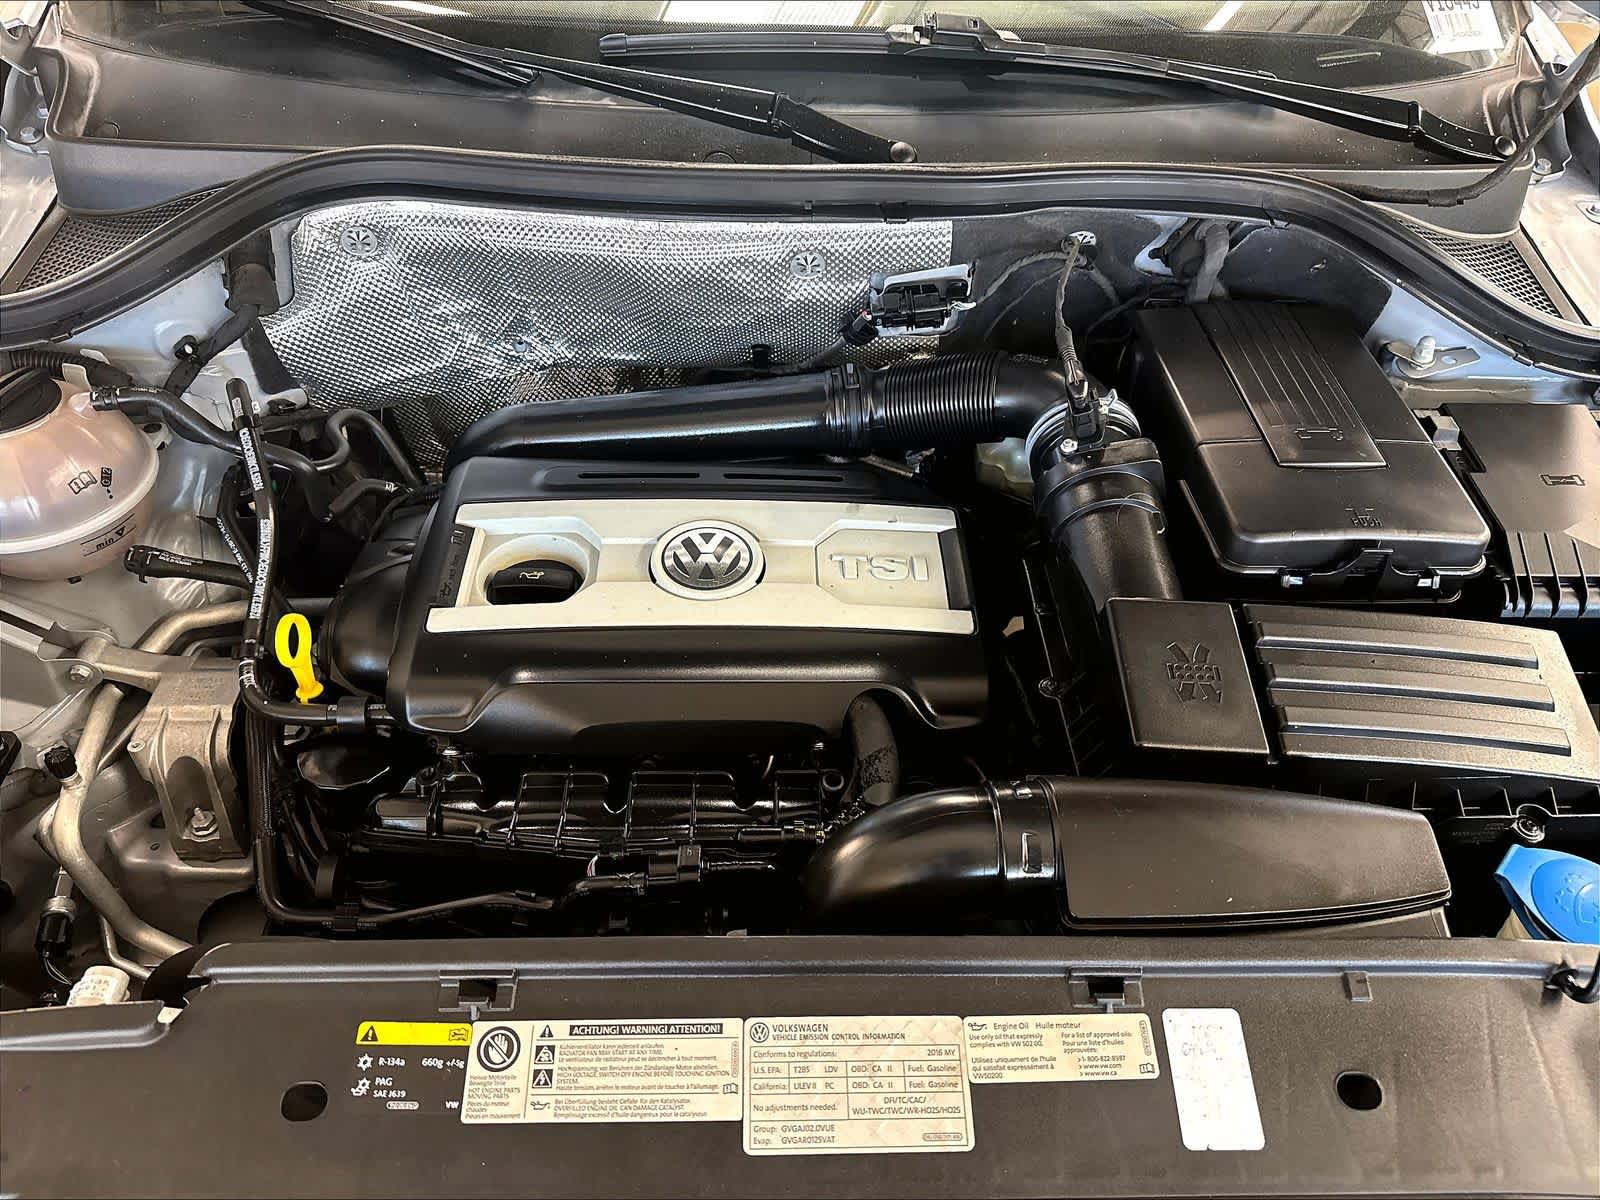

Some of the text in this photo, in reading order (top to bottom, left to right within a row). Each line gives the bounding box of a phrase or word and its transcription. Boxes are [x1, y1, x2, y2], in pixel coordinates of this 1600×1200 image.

[96, 536, 114, 550] min
[829, 554, 929, 582] TSI
[572, 1024, 720, 1035] ACHTUNG! WARNING! ATTENTION!
[772, 1024, 829, 1032] VOLKSWAGEN
[994, 1023, 1017, 1032] Engine
[378, 1058, 406, 1066] R-134a
[422, 1058, 444, 1069] 660g
[375, 1078, 392, 1086] PAG
[373, 1090, 406, 1098] SAE J639
[765, 1104, 808, 1112] adjustments
